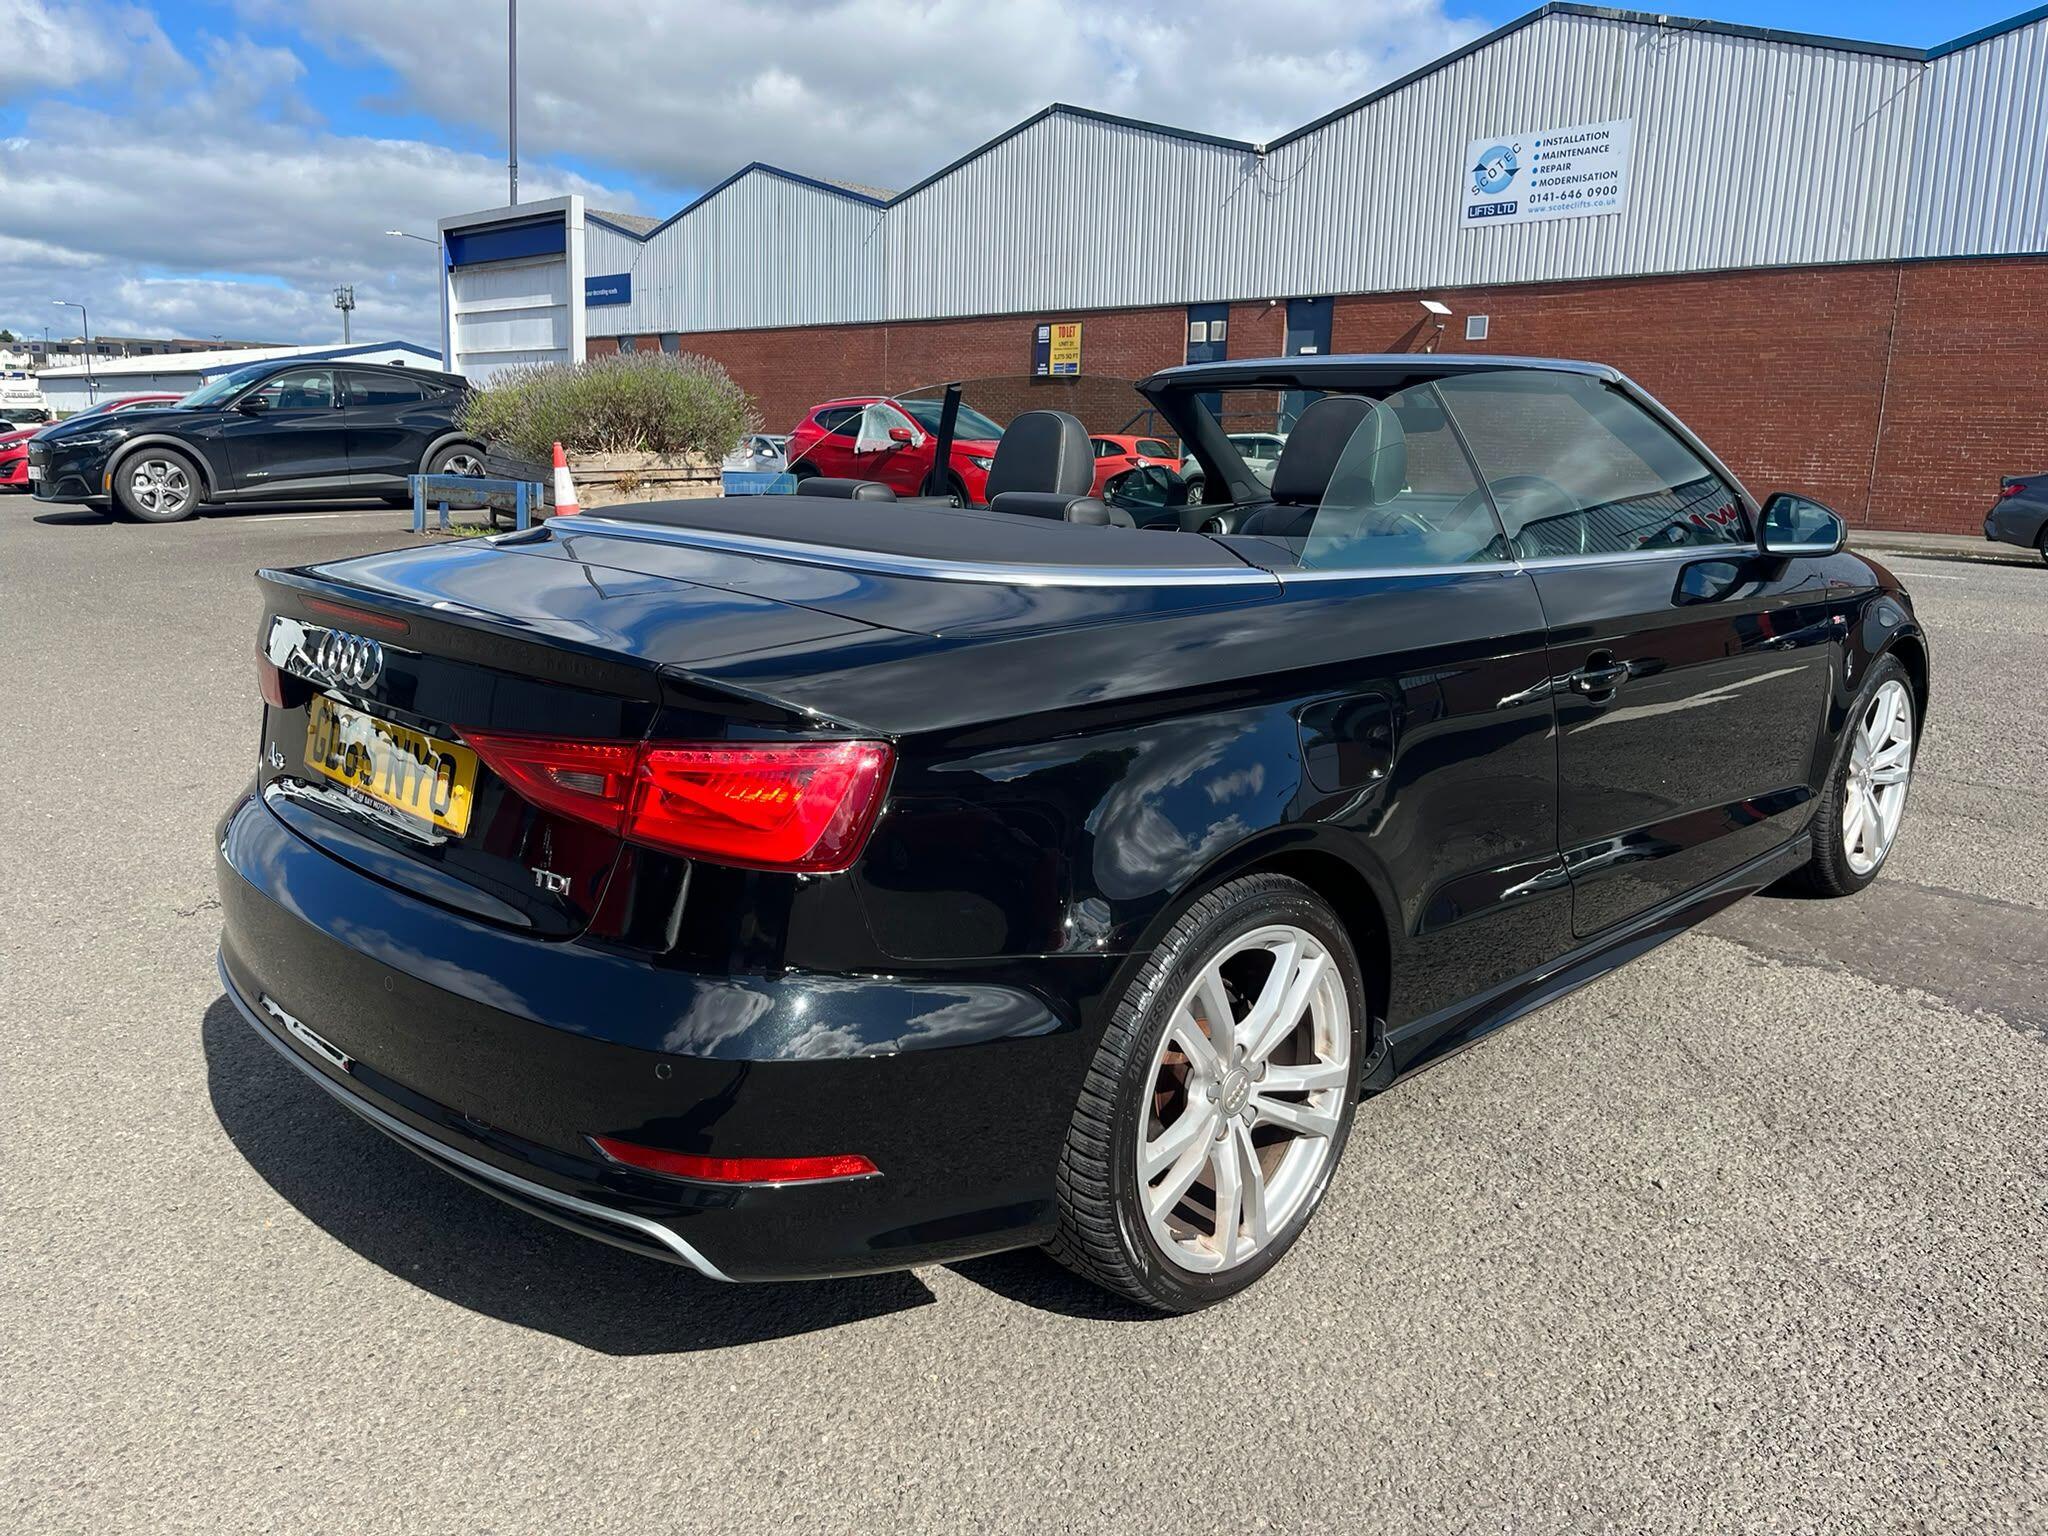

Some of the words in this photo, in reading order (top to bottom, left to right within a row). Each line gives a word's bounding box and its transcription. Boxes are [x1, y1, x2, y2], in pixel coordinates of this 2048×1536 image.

[1542, 131, 1610, 147] INSTALLATION
[1541, 144, 1610, 160] MAINTENANCE
[1471, 143, 1522, 196] SCOTEC
[1540, 162, 1572, 174] REPAIR
[1538, 170, 1619, 187] MODERNISATION
[1529, 189, 1582, 203] 0141-646
[1587, 185, 1618, 197] 0900
[1469, 205, 1495, 217] LIFTS
[1496, 202, 1517, 214] LTD
[1527, 198, 1616, 213] www.scoteclifts.co.uk
[1058, 326, 1066, 338] TO
[1066, 325, 1077, 338] LET
[384, 733, 457, 818] NYO
[531, 866, 572, 896] TDI
[1128, 966, 1189, 1081] BRIDGESTONE
